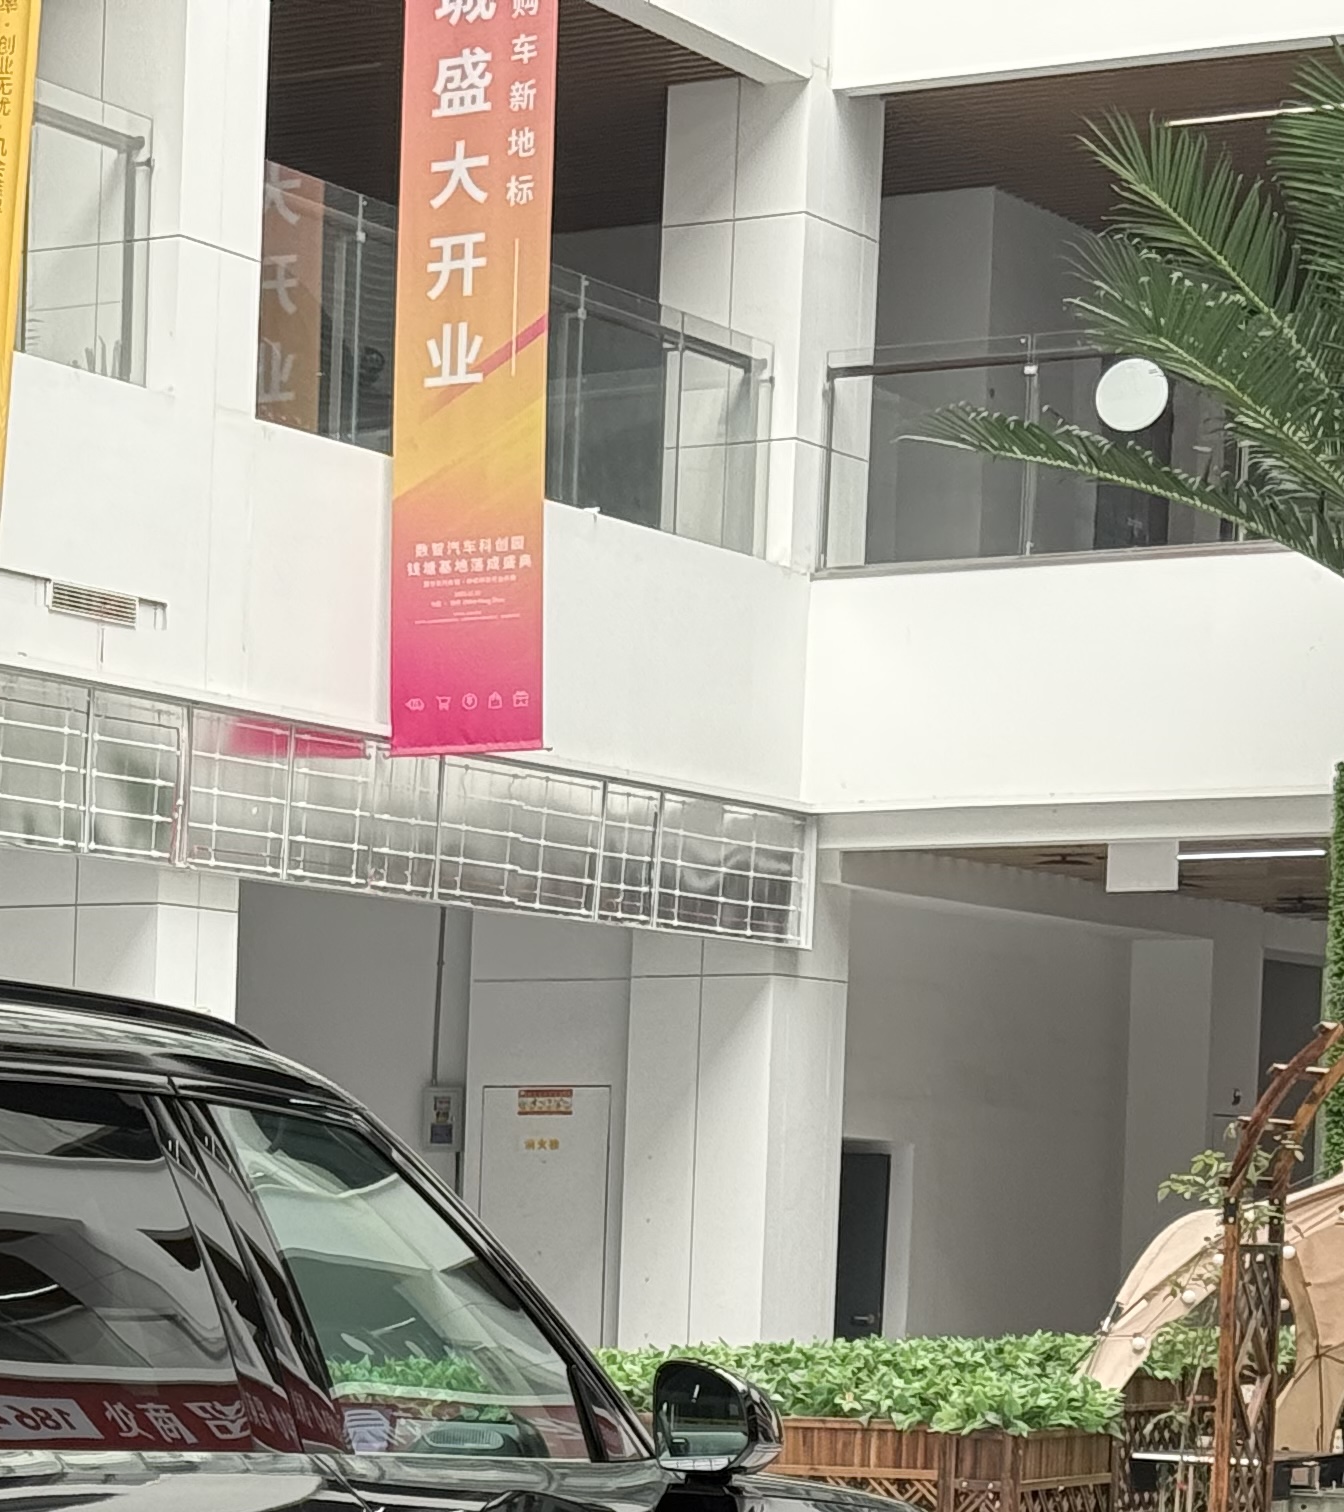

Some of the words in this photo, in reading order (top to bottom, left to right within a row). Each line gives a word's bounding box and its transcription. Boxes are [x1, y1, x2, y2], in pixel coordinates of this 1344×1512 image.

[505, 0, 538, 207] 购车新地标
